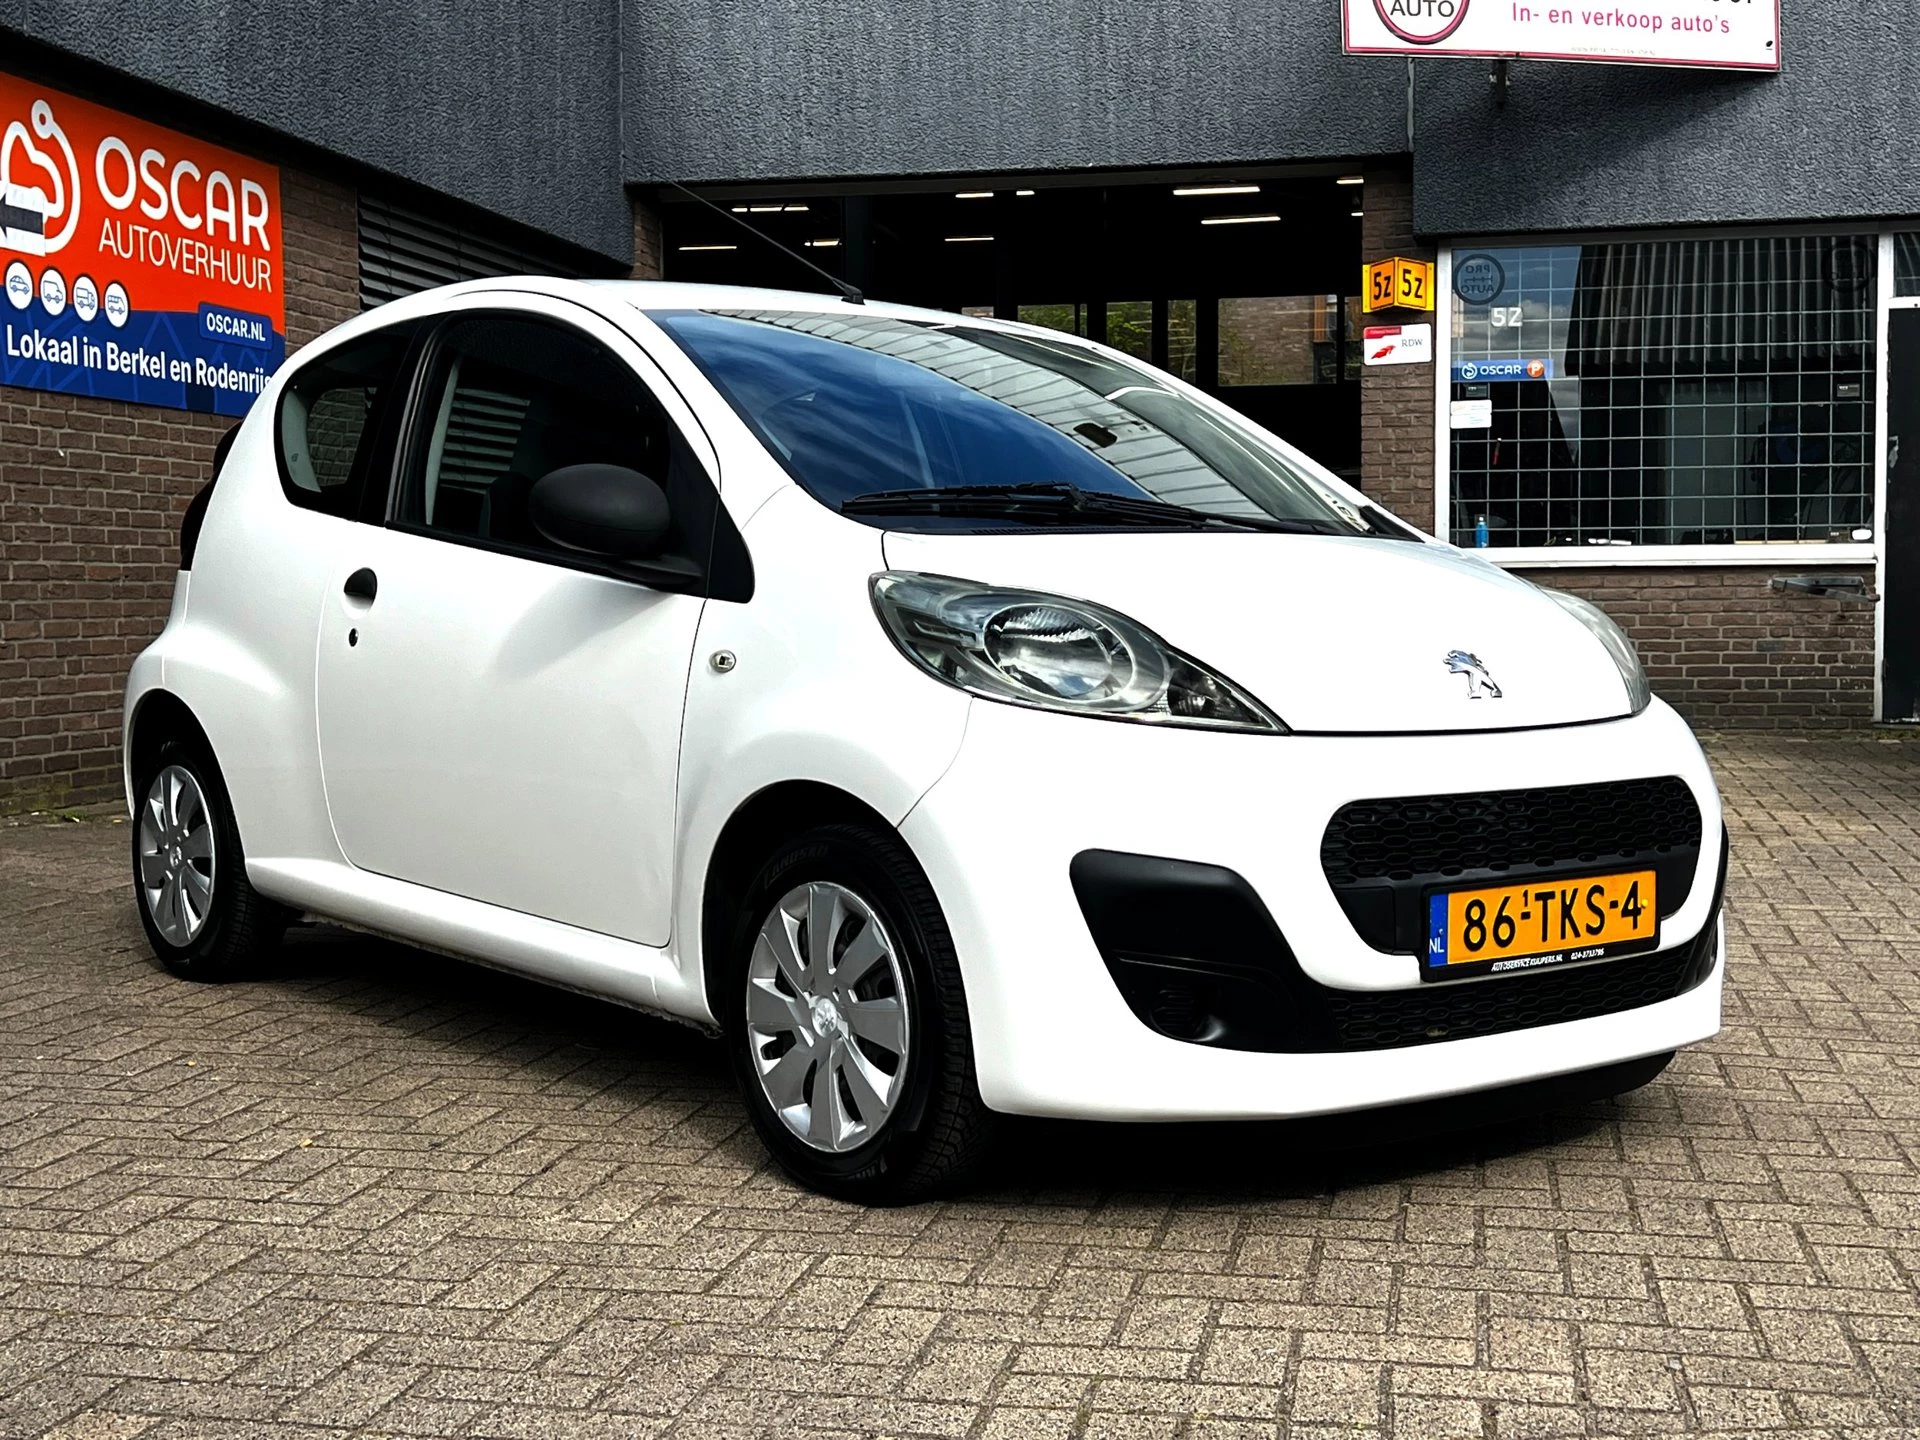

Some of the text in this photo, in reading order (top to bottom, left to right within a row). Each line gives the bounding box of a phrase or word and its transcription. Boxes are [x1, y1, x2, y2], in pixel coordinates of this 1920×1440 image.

[1390, 0, 1455, 18] AUTO
[1512, 2, 1730, 33] In- en verkoop auto's
[95, 136, 271, 252] OSCAR
[98, 217, 272, 293] AUTOVERHUUR
[206, 312, 267, 342] OSCAR.NL
[6, 324, 78, 366] Lokaal
[83, 337, 101, 370] in
[107, 341, 166, 380] Berkel
[170, 360, 192, 384] en
[1401, 338, 1423, 347] RDW
[1480, 365, 1522, 375] OSCAR
[1463, 880, 1642, 952] 86-TKS-4
[1429, 936, 1445, 953] NL
